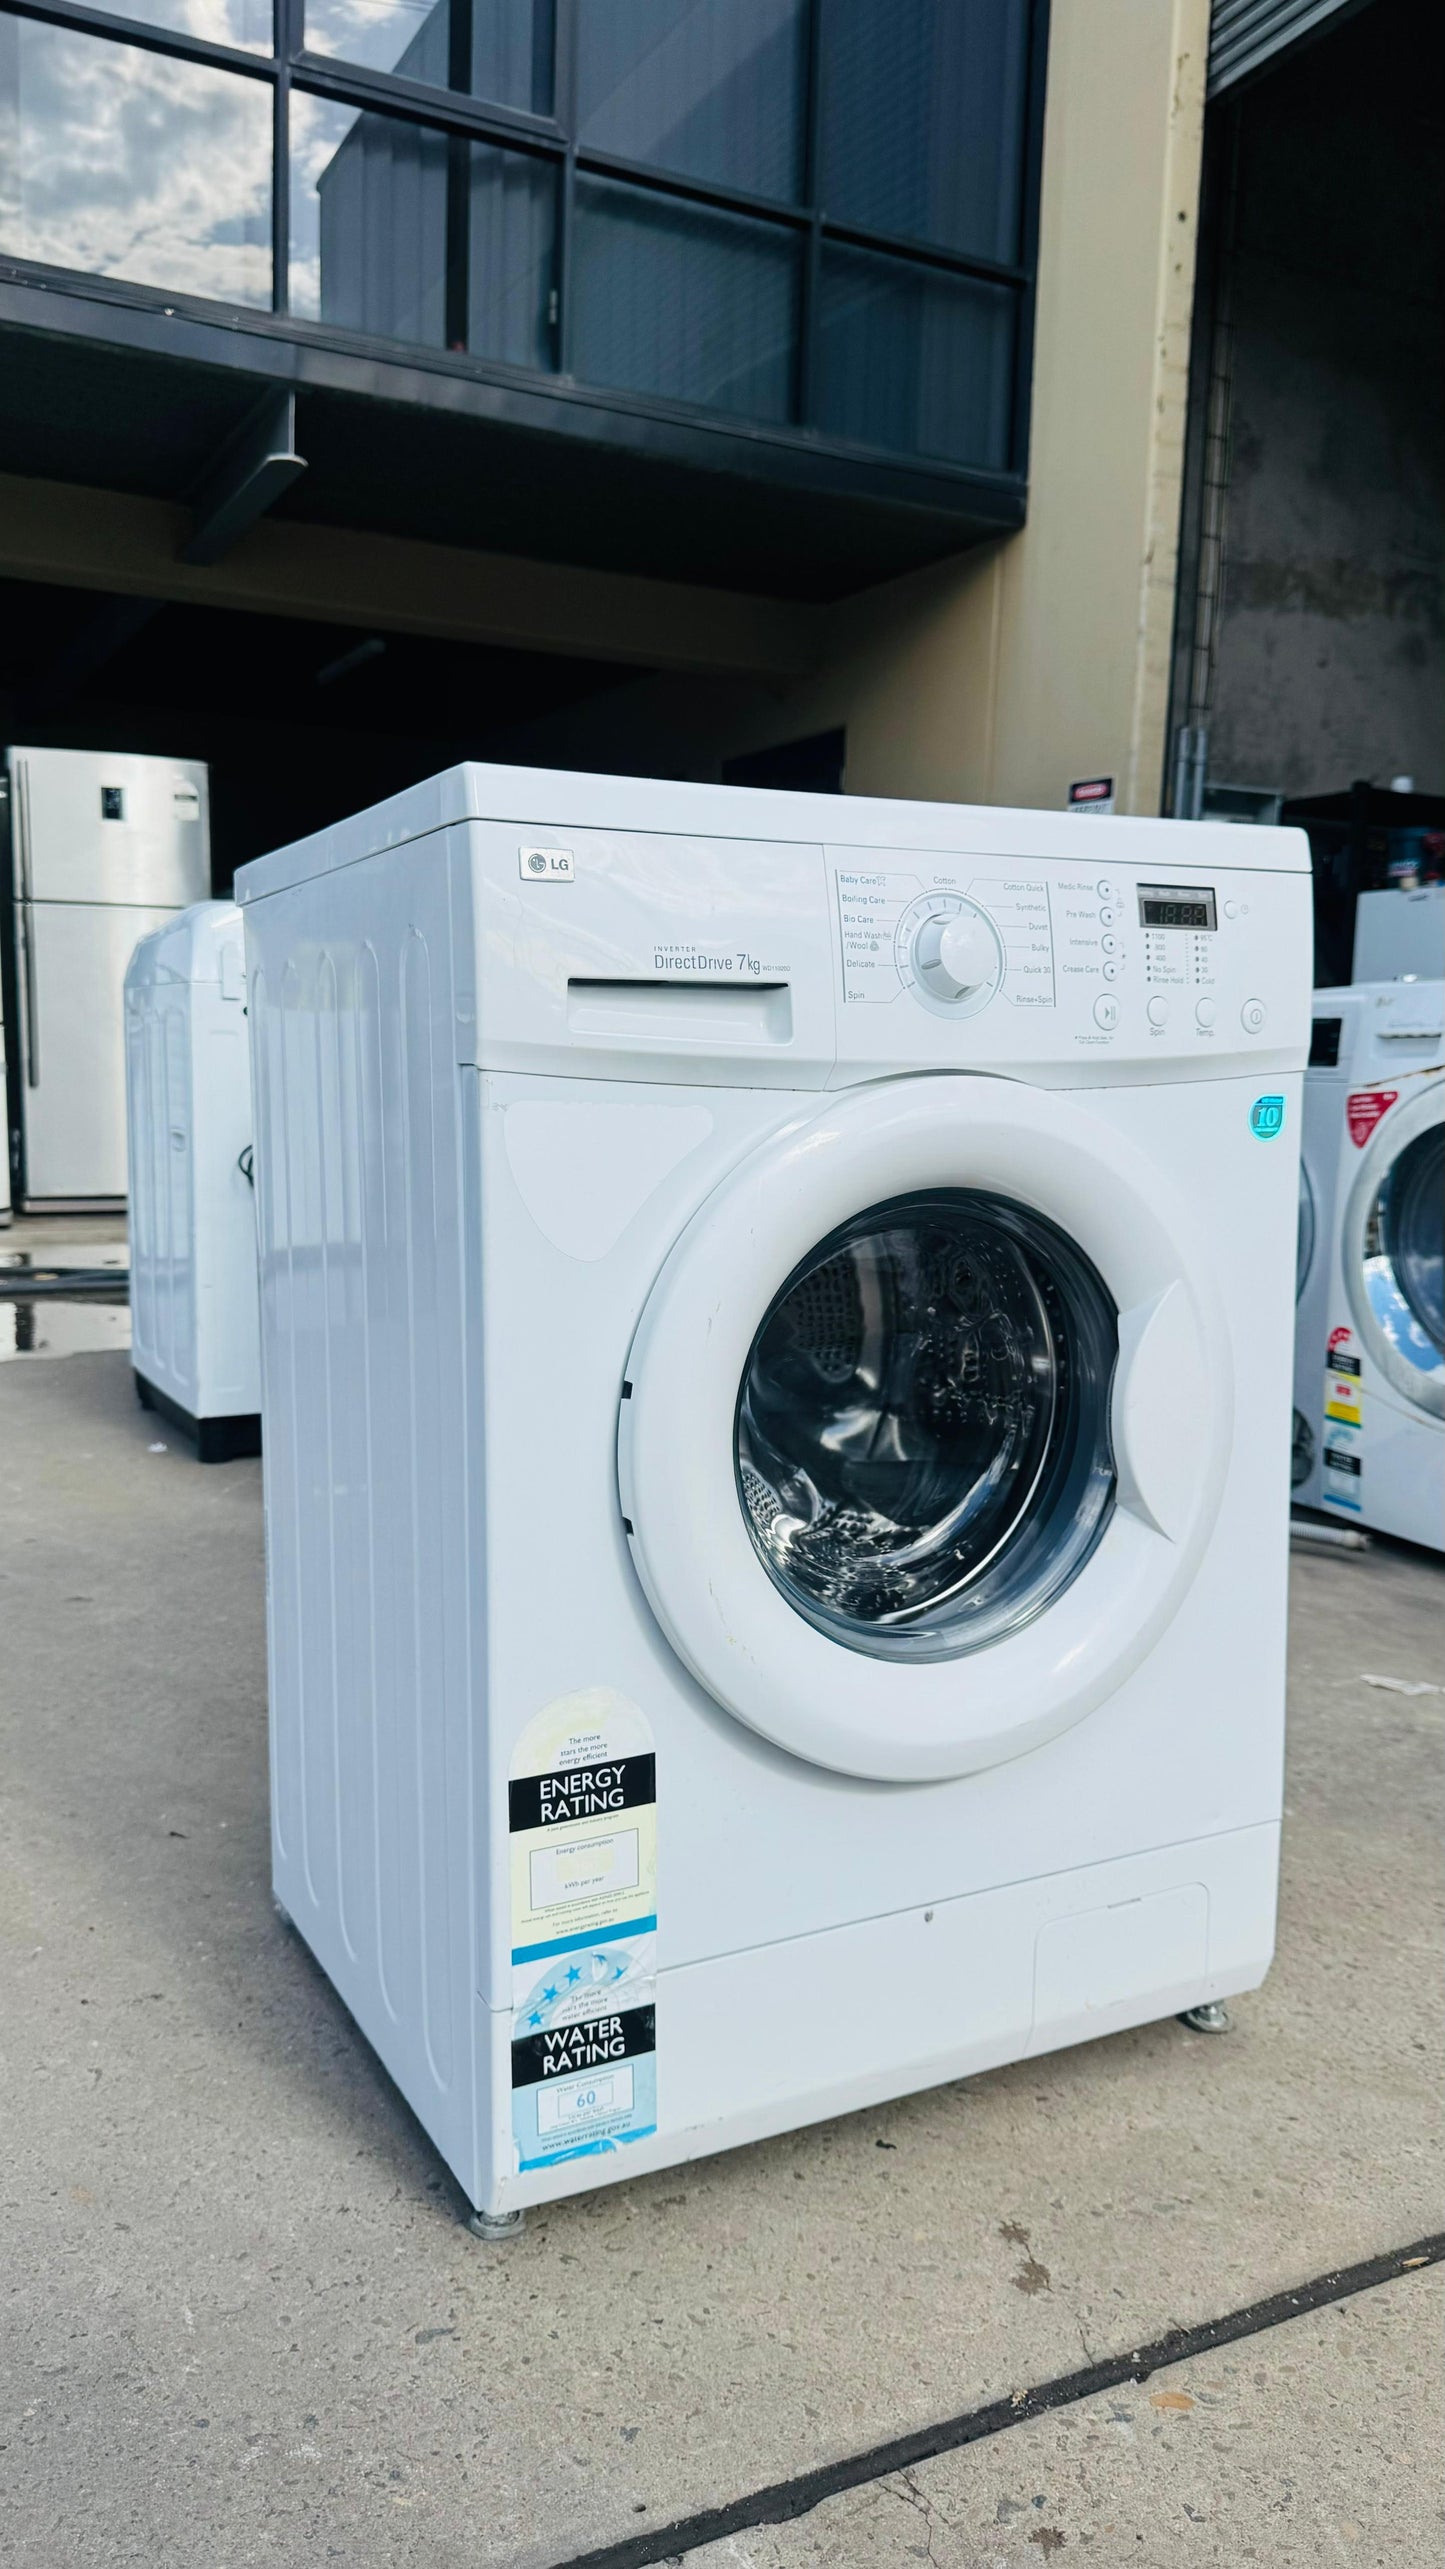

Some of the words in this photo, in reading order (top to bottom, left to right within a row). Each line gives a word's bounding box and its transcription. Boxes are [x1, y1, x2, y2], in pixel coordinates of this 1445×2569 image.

[551, 858, 569, 870] LG
[840, 875, 858, 884] Baby
[860, 876, 876, 885] Care
[933, 876, 956, 885] Cotton
[1003, 883, 1025, 891] Cotton
[1026, 884, 1044, 892] Quick
[842, 894, 867, 905] Boiling
[869, 895, 885, 904] Care
[1016, 903, 1046, 912] Synthetic
[843, 914, 856, 923] Bio
[857, 915, 874, 924] Care
[1079, 911, 1096, 919] Wash
[1029, 923, 1048, 931] Duvet
[844, 931, 862, 939] Hand
[863, 932, 882, 940] Wash
[1070, 938, 1098, 946] Intensive
[1031, 943, 1049, 953] Bulky
[846, 959, 876, 968] Delicate
[1063, 964, 1084, 973] Crease
[1085, 965, 1099, 973] Care
[1024, 965, 1041, 974] Quick
[1041, 966, 1051, 974] 30
[848, 991, 865, 1000] Spin
[1149, 1028, 1165, 1037] Spin
[1257, 1107, 1279, 1126] 10
[569, 1737, 581, 1745] The
[583, 1735, 601, 1743] more
[590, 1743, 608, 1751] more
[559, 1757, 581, 1765] energy
[583, 1751, 608, 1761] efficient
[539, 1765, 626, 1800] ENERGY
[540, 1788, 624, 1823] RATING
[556, 1844, 576, 1855] Energy
[577, 1838, 614, 1851] consumption
[564, 1881, 580, 1889] kWh
[580, 1879, 591, 1887] per
[592, 1876, 605, 1885] year
[544, 2016, 623, 2052] WATER
[543, 2036, 625, 2075] RATING
[576, 2090, 596, 2108] 60
